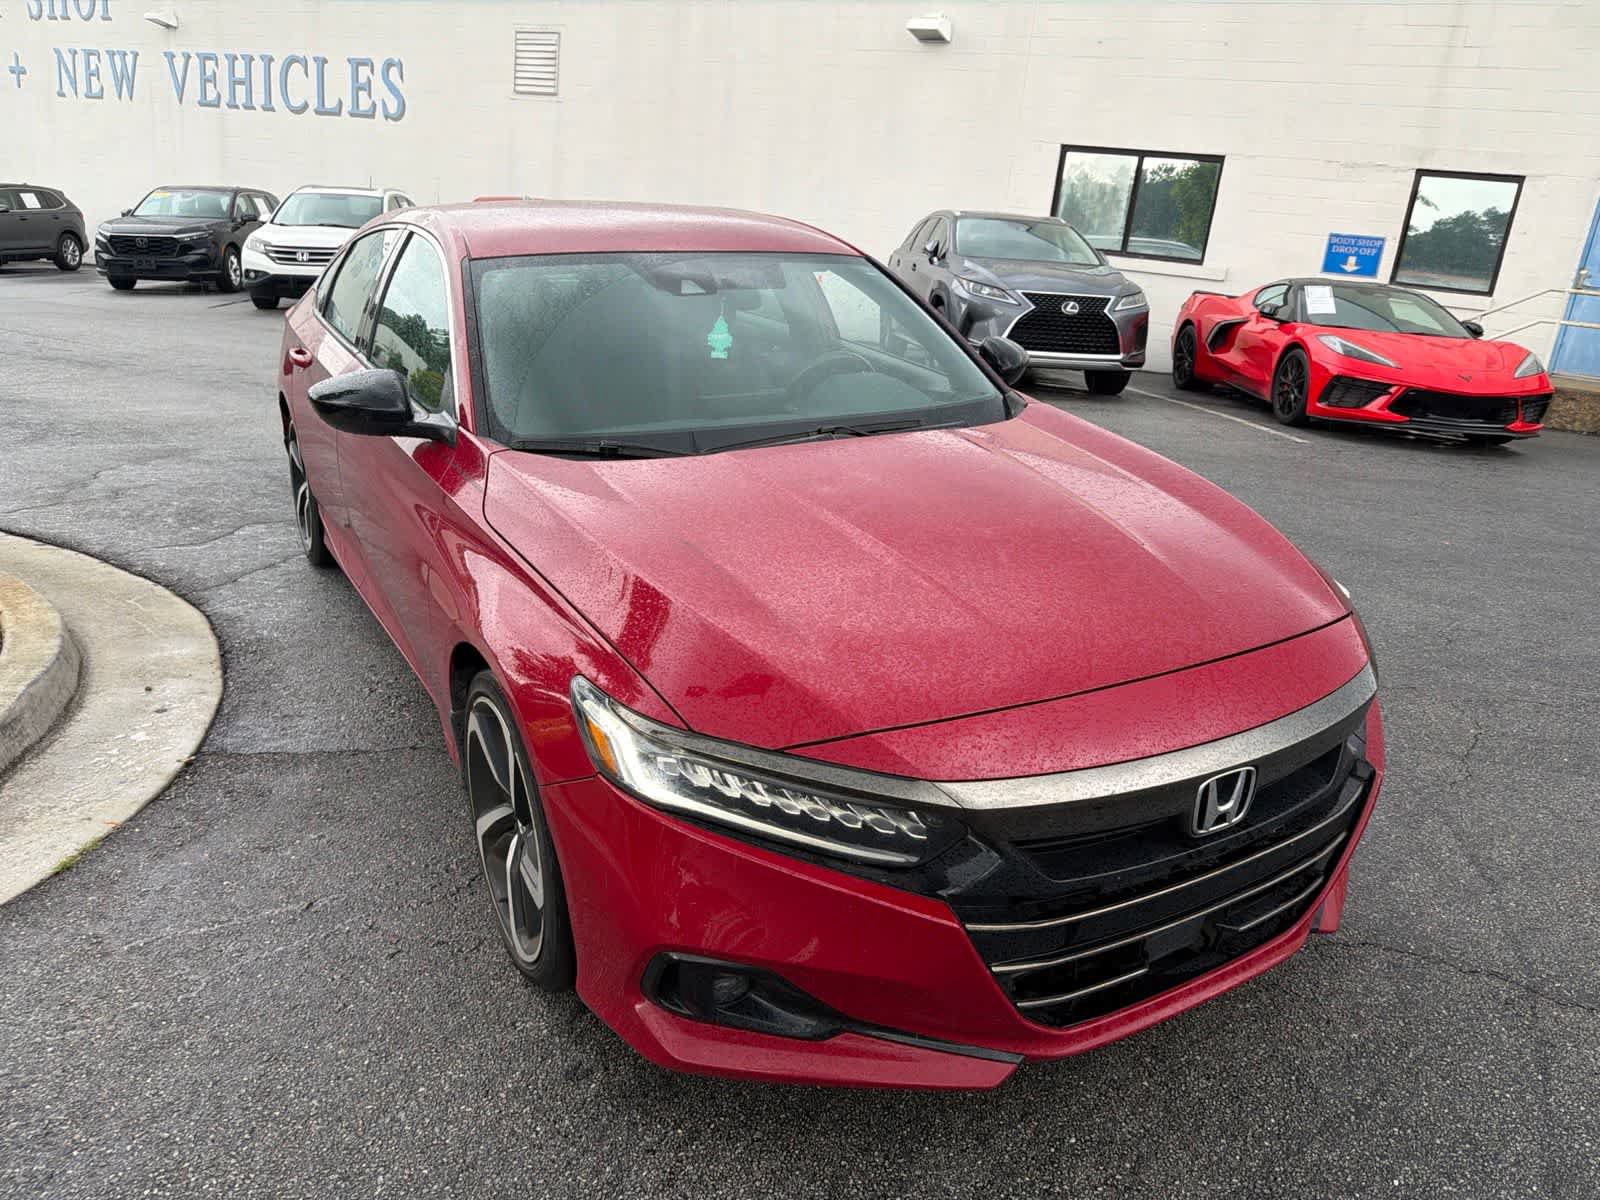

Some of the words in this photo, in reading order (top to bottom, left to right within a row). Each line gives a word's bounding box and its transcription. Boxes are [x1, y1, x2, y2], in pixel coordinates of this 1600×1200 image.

[53, 48, 140, 102] NEW
[163, 51, 407, 122] VEHICLES
[1330, 236, 1357, 245] BODY
[1357, 238, 1383, 248] SHOP
[1332, 245, 1358, 254] DROP
[1359, 247, 1377, 256] OFF
